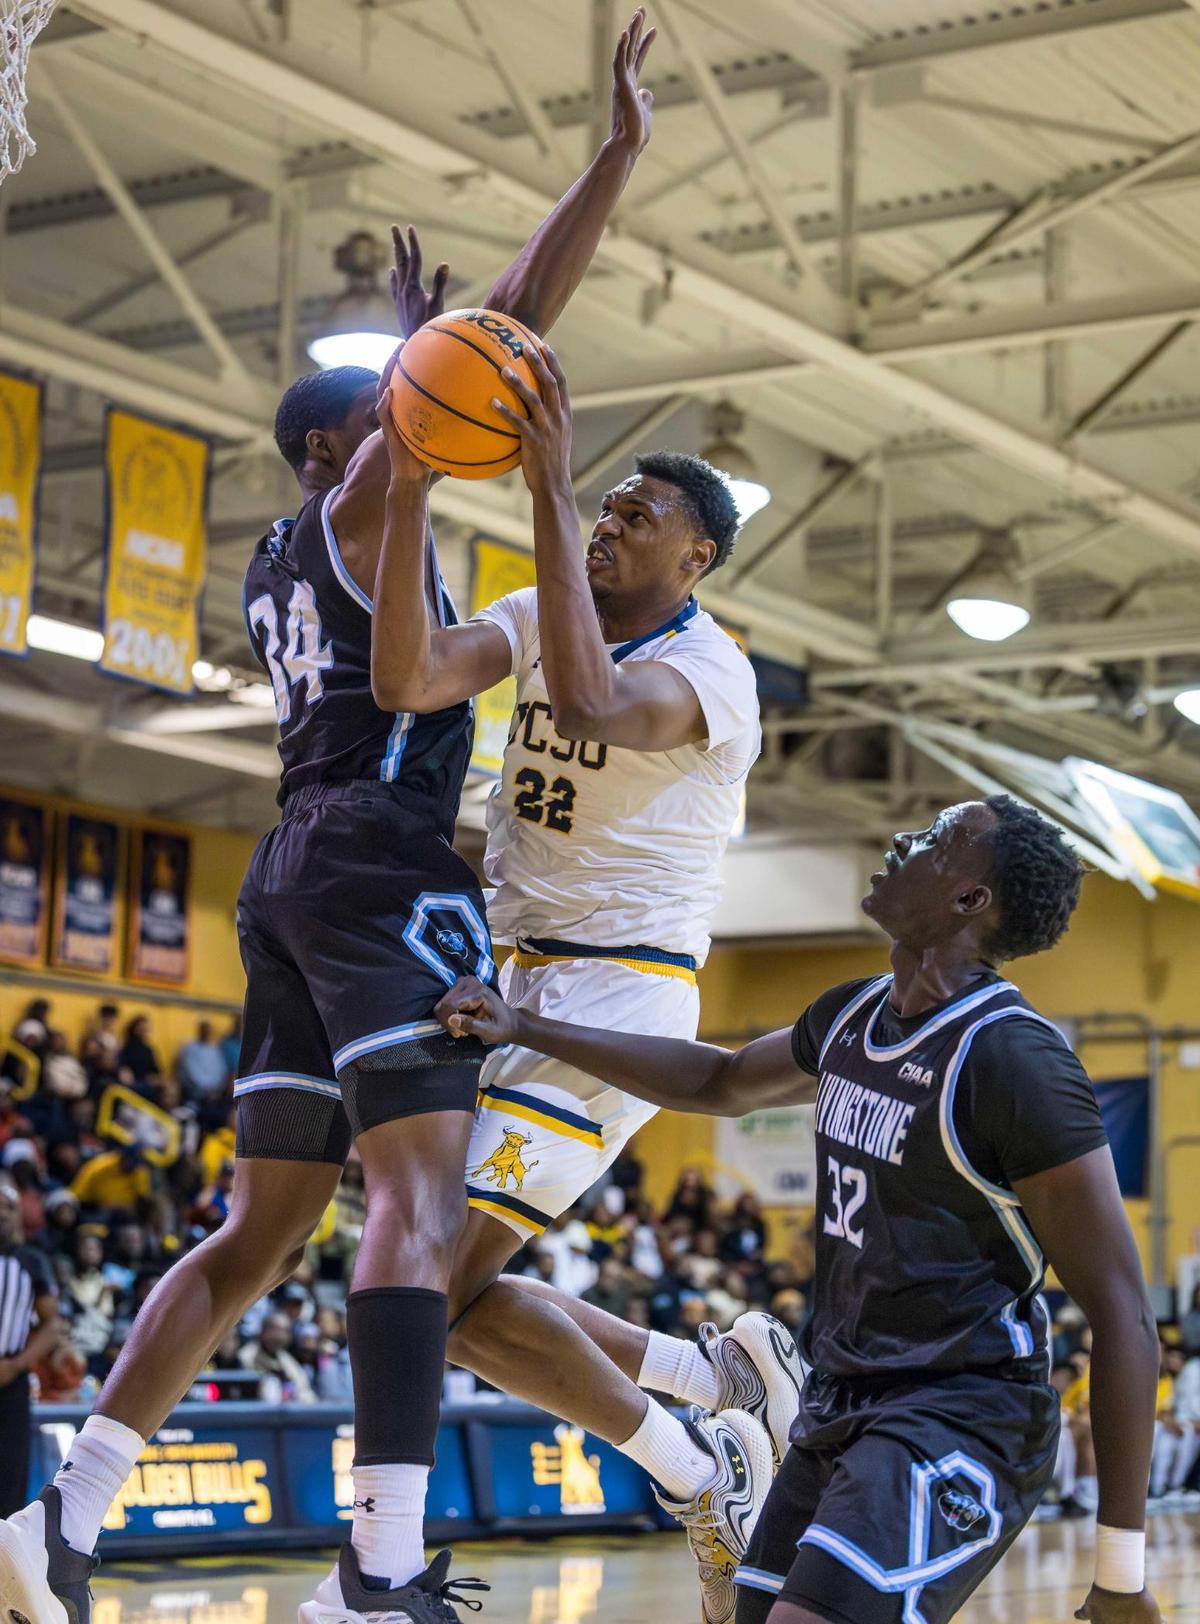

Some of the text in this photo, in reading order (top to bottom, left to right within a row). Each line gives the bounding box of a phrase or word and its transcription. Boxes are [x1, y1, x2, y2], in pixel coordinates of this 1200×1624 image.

[513, 766, 578, 835] 22
[897, 1061, 933, 1089] CIAA
[823, 1155, 867, 1249] 32
